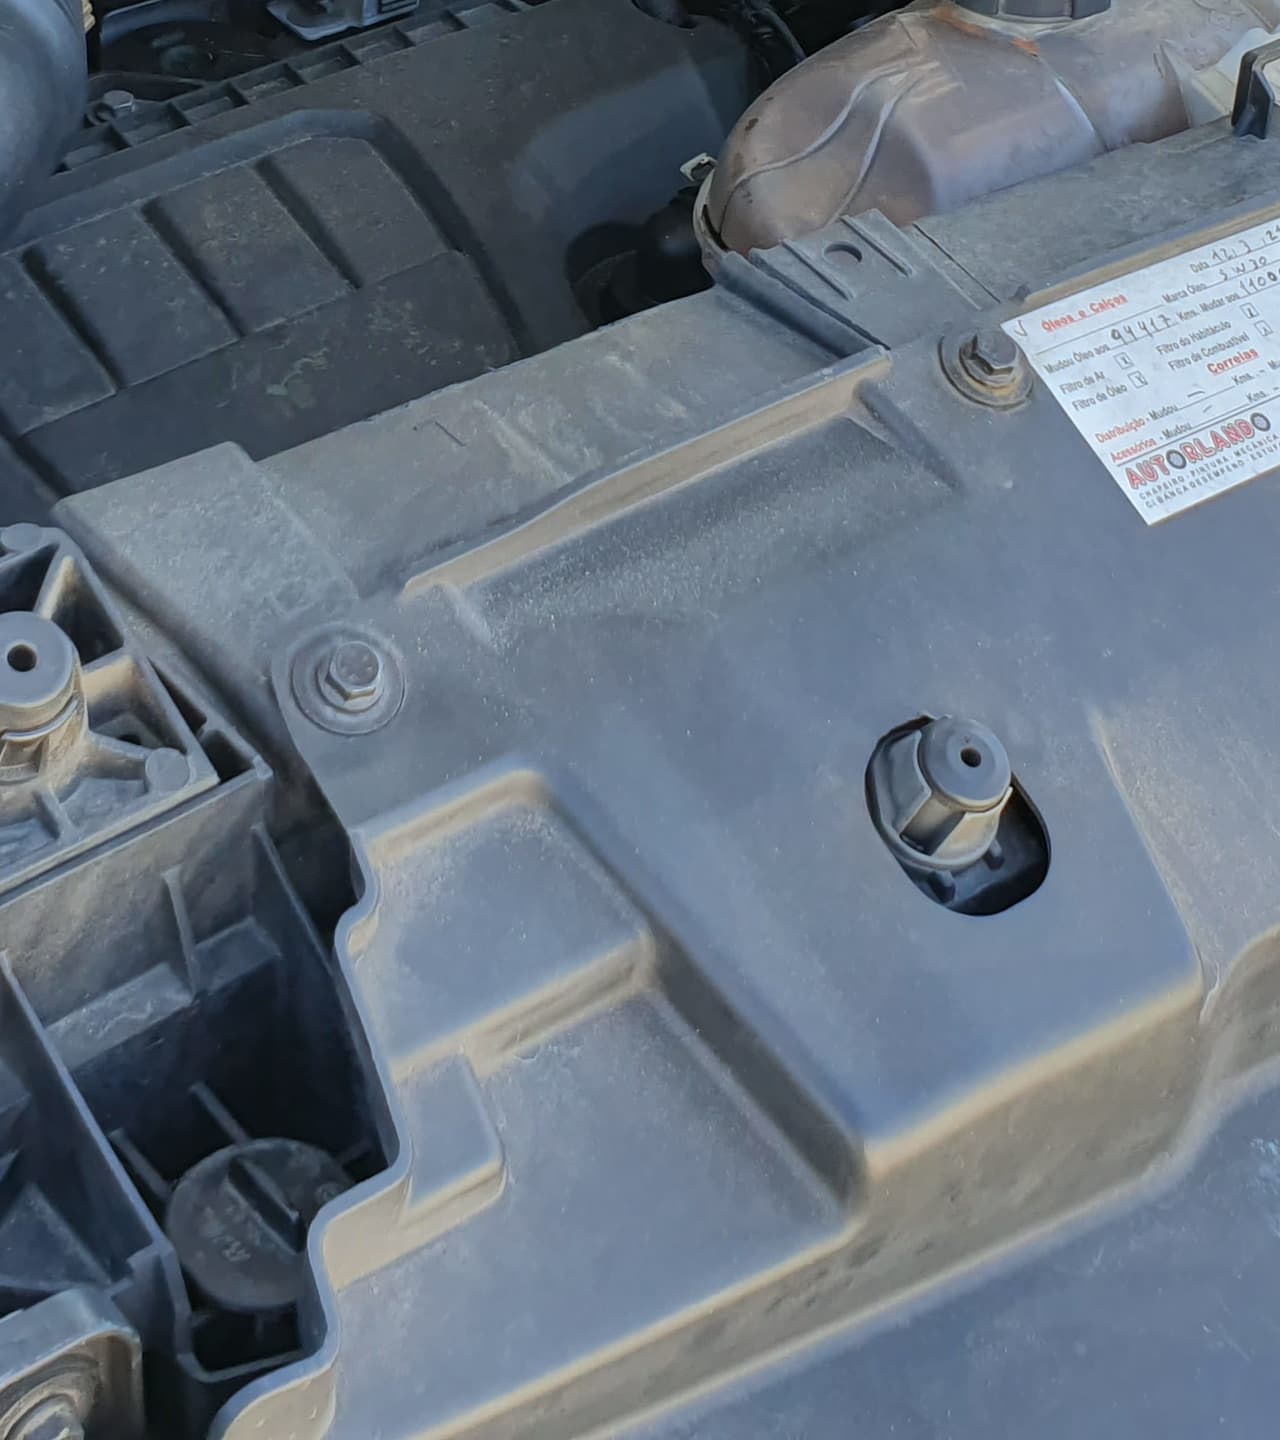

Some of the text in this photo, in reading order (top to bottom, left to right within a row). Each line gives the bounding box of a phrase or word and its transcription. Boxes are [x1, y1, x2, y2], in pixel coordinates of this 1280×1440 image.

[1189, 260, 1211, 273] Data
[1161, 280, 1209, 303] Marca Óleo
[1198, 297, 1226, 313] Mudar
[1224, 292, 1242, 304] aos
[1041, 294, 1128, 332] Óleos e Calços
[1042, 343, 1111, 374] Mudou Óleo aos
[1155, 340, 1180, 356] Filtro
[1167, 356, 1192, 371] Filtro
[1200, 331, 1250, 358] Combustível
[1206, 348, 1258, 374] Correias
[1058, 379, 1084, 395] Filtro
[1092, 370, 1106, 381] Ar
[1071, 396, 1097, 412] Filtro
[1105, 381, 1128, 397] Óleo
[1094, 415, 1146, 443] Distribuição
[1148, 404, 1180, 421] Mudou
[1110, 437, 1157, 463] Acessórios
[1161, 422, 1193, 440] Mudou
[1126, 412, 1271, 489] AUTORLANDO
[1138, 433, 1279, 500] CHAPEIRO PINTURA MECÂNICA
